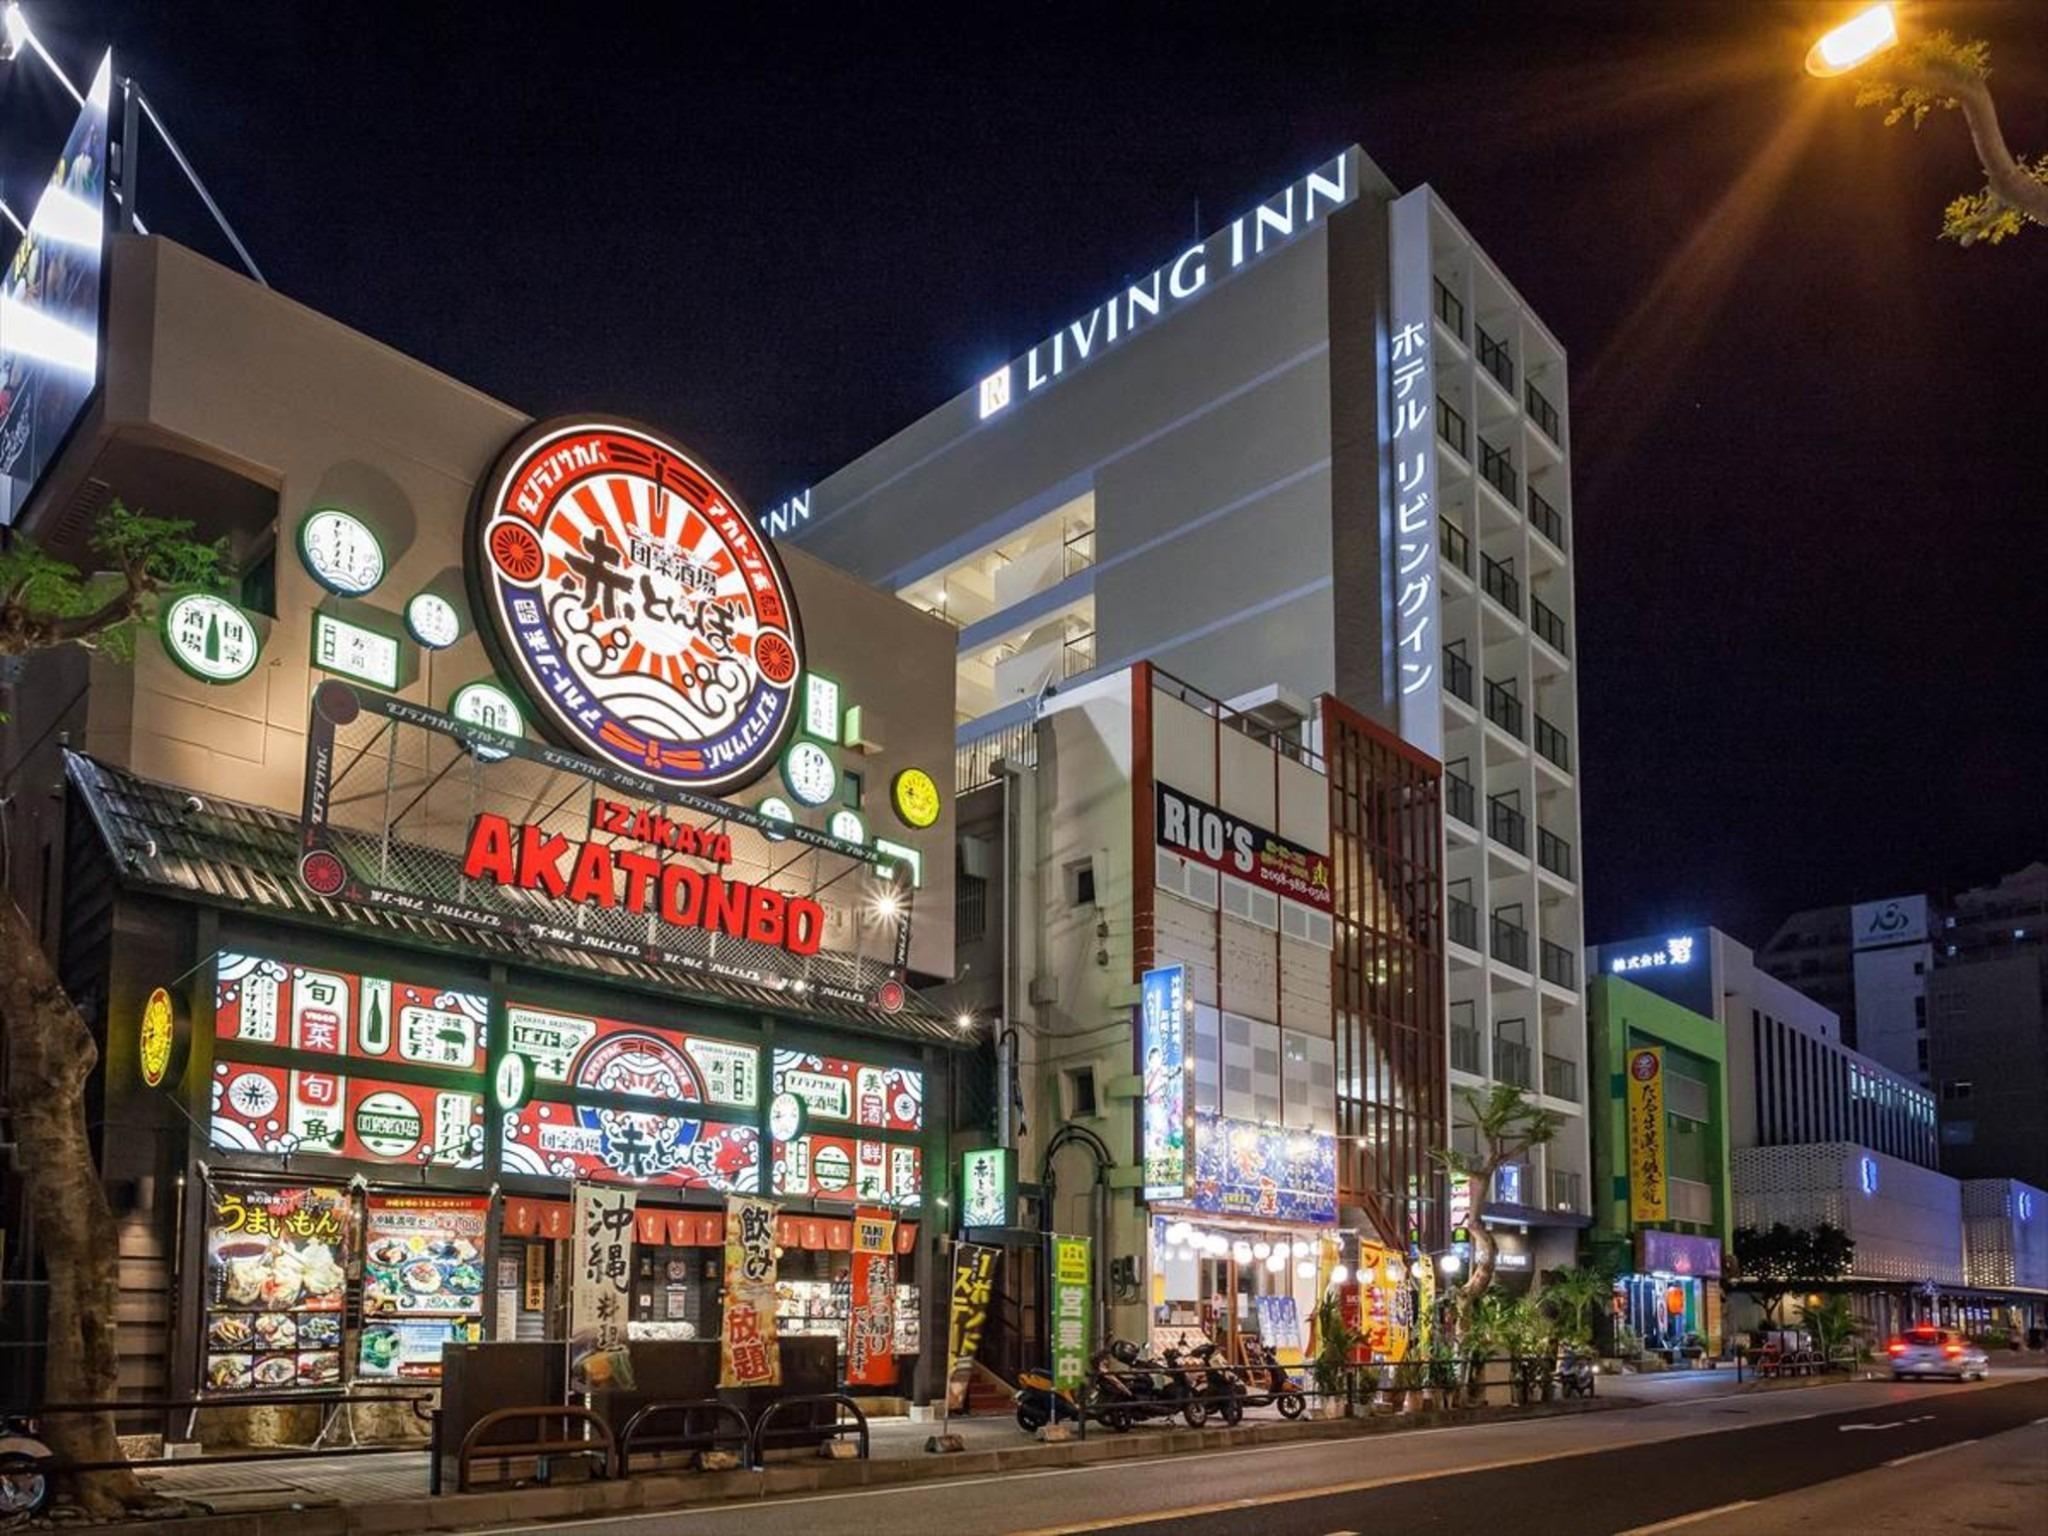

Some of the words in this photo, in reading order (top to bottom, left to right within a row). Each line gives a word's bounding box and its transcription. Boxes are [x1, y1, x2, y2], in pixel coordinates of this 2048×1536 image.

[1028, 244, 1206, 391] LIVING
[1232, 153, 1346, 267] INN
[1392, 322, 1427, 439] ホテル
[560, 527, 746, 653] 赤とんぼ
[1398, 452, 1432, 695] リビングイン
[463, 812, 825, 957] AKATONBO
[595, 798, 733, 865] IZAKAYA
[1163, 792, 1254, 873] RIO'S
[1612, 950, 1666, 973] 株式会社
[217, 1193, 340, 1240] うまいもん
[587, 1193, 634, 1352] 沖縄料理
[728, 1205, 775, 1382] 飲み放題
